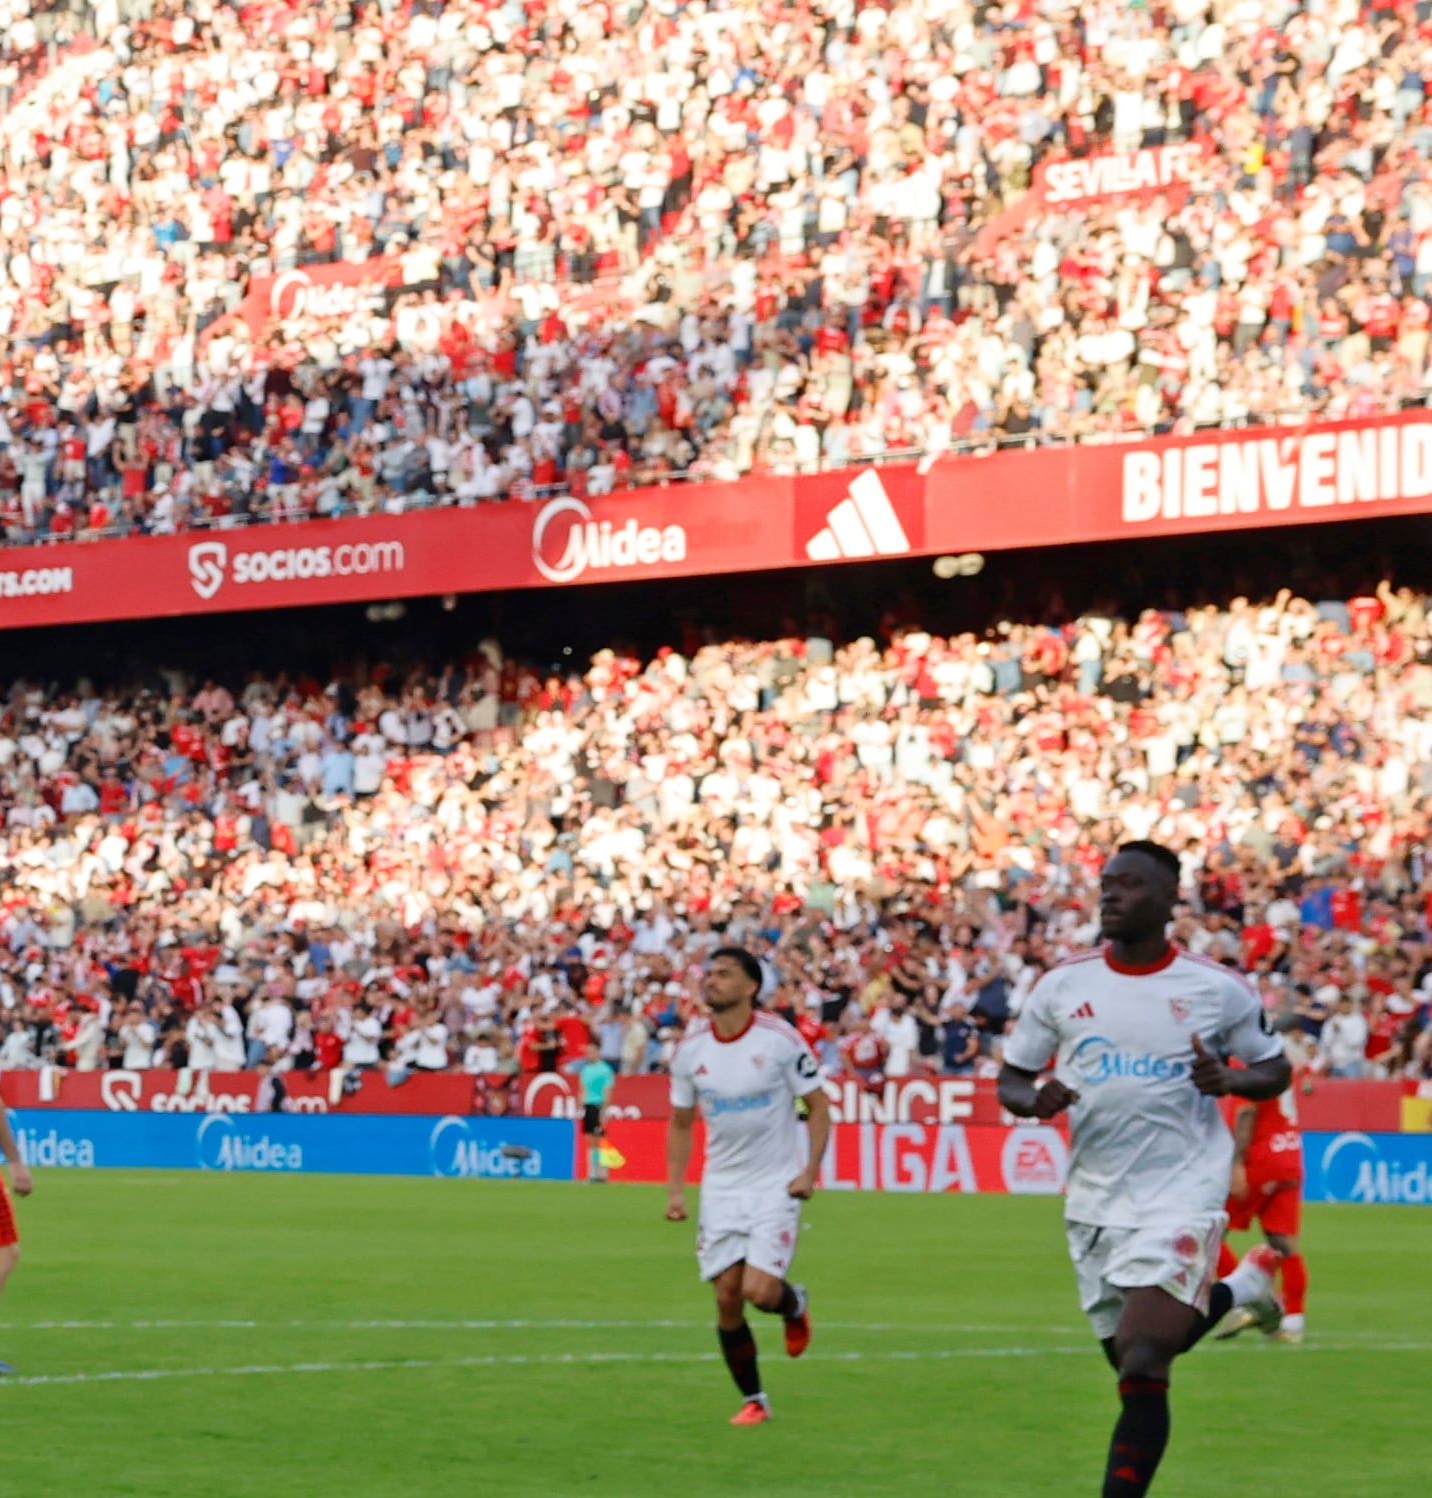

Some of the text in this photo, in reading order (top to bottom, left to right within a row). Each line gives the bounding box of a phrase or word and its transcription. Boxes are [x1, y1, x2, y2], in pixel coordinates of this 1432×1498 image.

[1044, 149, 1158, 203] SEVILLA
[551, 517, 687, 579] Midea
[214, 1134, 303, 1170] Midea
[822, 1124, 978, 1192] LIGA
